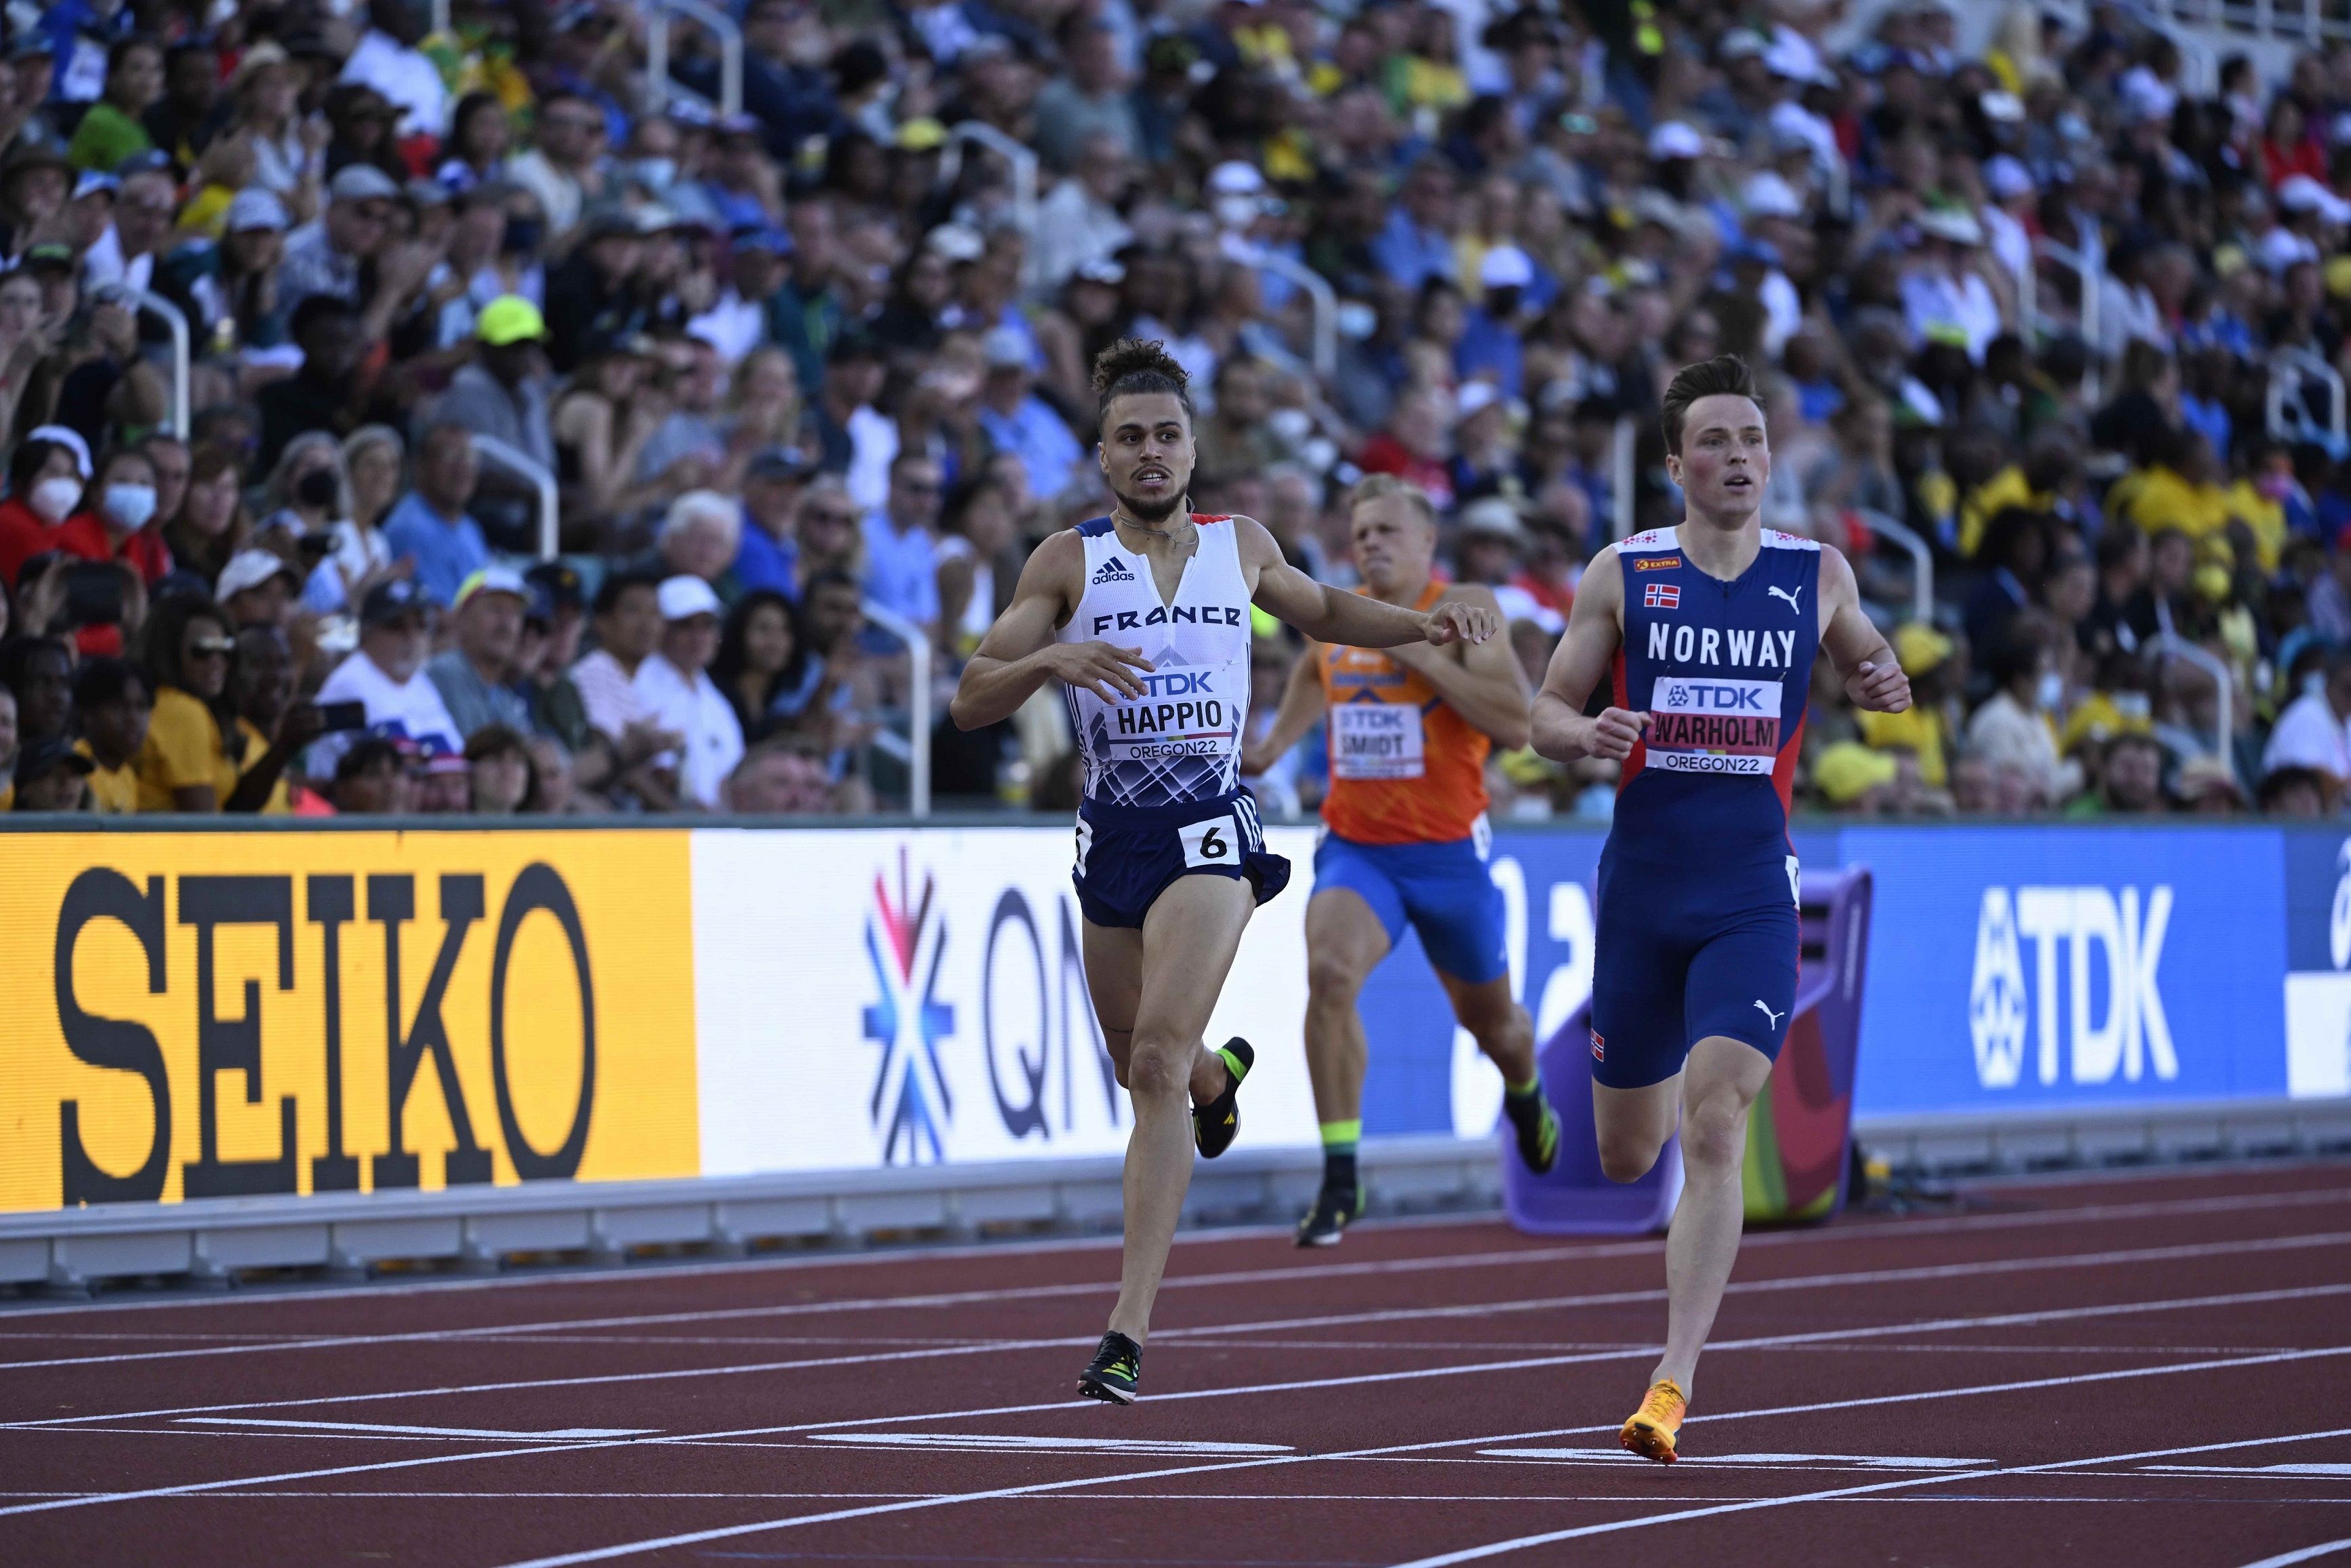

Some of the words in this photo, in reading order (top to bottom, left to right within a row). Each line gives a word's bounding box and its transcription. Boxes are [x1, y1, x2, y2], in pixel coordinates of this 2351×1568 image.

[1092, 571, 1135, 585] adidas
[1093, 605, 1241, 635] FRANCE
[1648, 622, 1796, 668] NORWAY
[1140, 671, 1213, 698] TDK
[1689, 685, 1763, 710] TDK
[1117, 700, 1222, 734] HAPPIO
[1655, 714, 1774, 746] WARHOLM
[1130, 740, 1217, 759] OREGON22
[1666, 755, 1759, 771] OREGON22
[1200, 827, 1228, 859] 6
[2016, 885, 2179, 1085] TDK
[54, 861, 597, 1208] SEIKO
